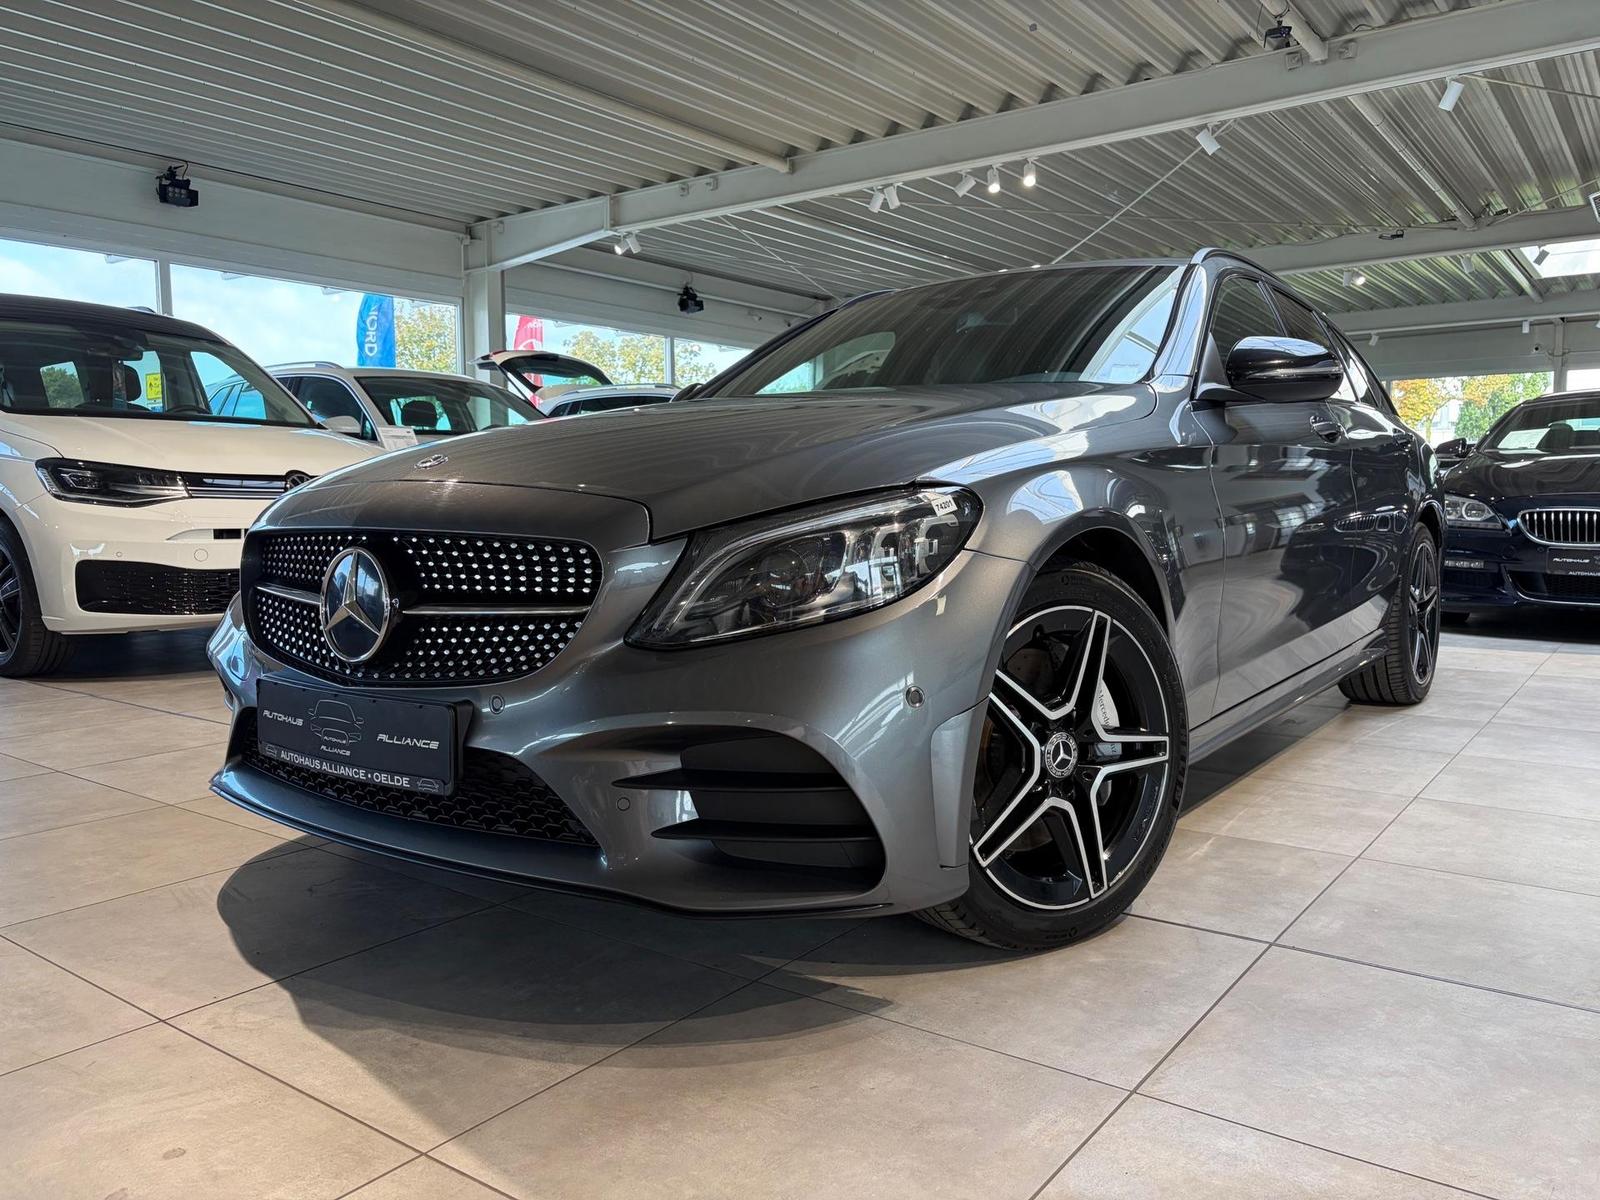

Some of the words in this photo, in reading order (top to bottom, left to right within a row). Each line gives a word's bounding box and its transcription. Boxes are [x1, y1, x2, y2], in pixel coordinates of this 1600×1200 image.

[263, 709, 304, 727] AUTOHAUS
[323, 736, 348, 744] AUTOHAUS
[377, 733, 440, 750] ALLIANCE
[320, 745, 351, 756] ALLIANCE
[280, 750, 321, 770] AUTOHAUS
[321, 762, 367, 780] ALLIANCE
[373, 772, 411, 788] OELDE
